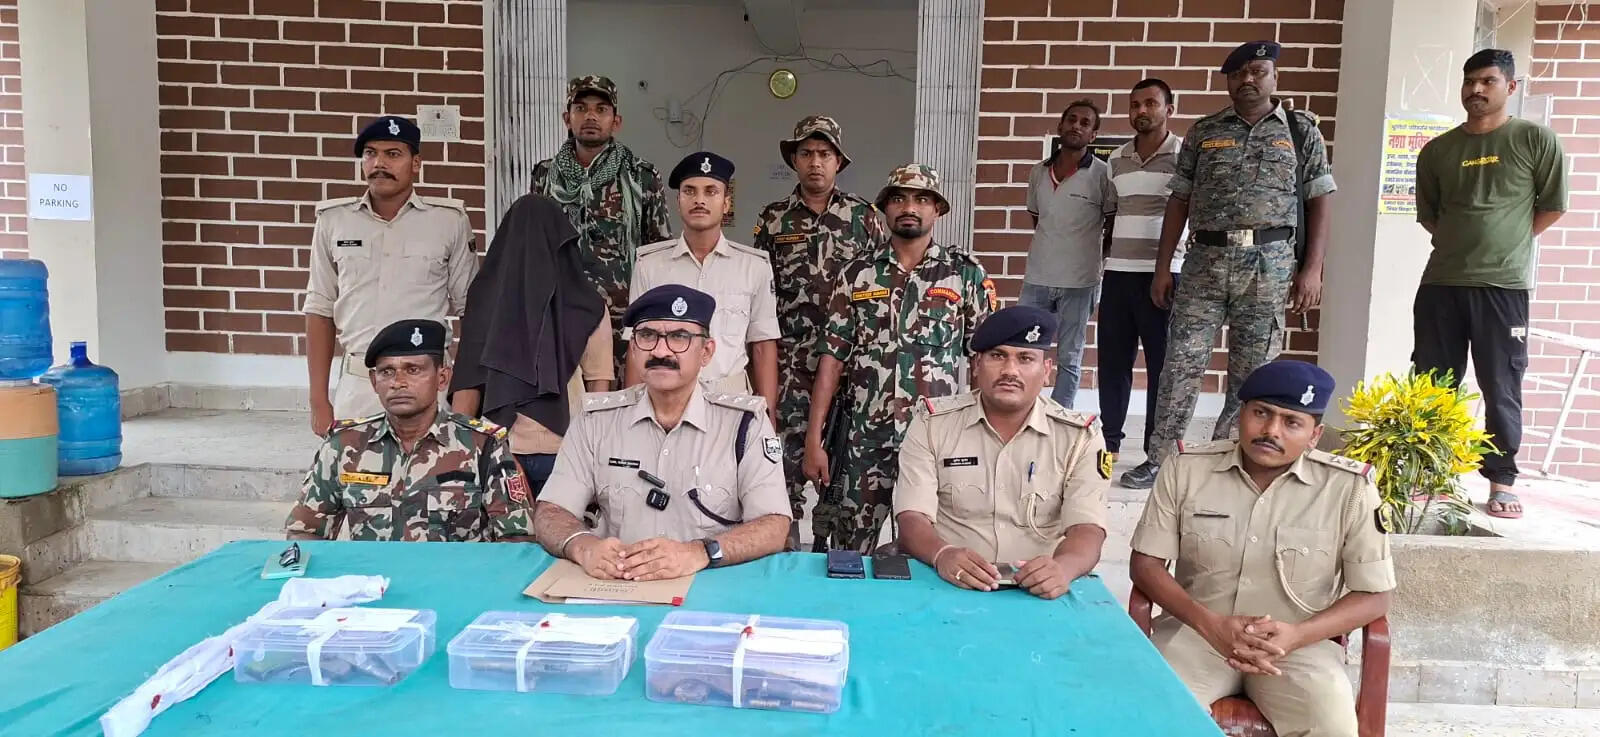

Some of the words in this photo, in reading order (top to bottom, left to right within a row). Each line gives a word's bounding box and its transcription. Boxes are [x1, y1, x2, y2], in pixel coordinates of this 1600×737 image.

[1388, 135, 1406, 149] नशा
[53, 183, 68, 192] NO
[39, 198, 80, 209] PARKING
[930, 289, 958, 300] COMMANDO
